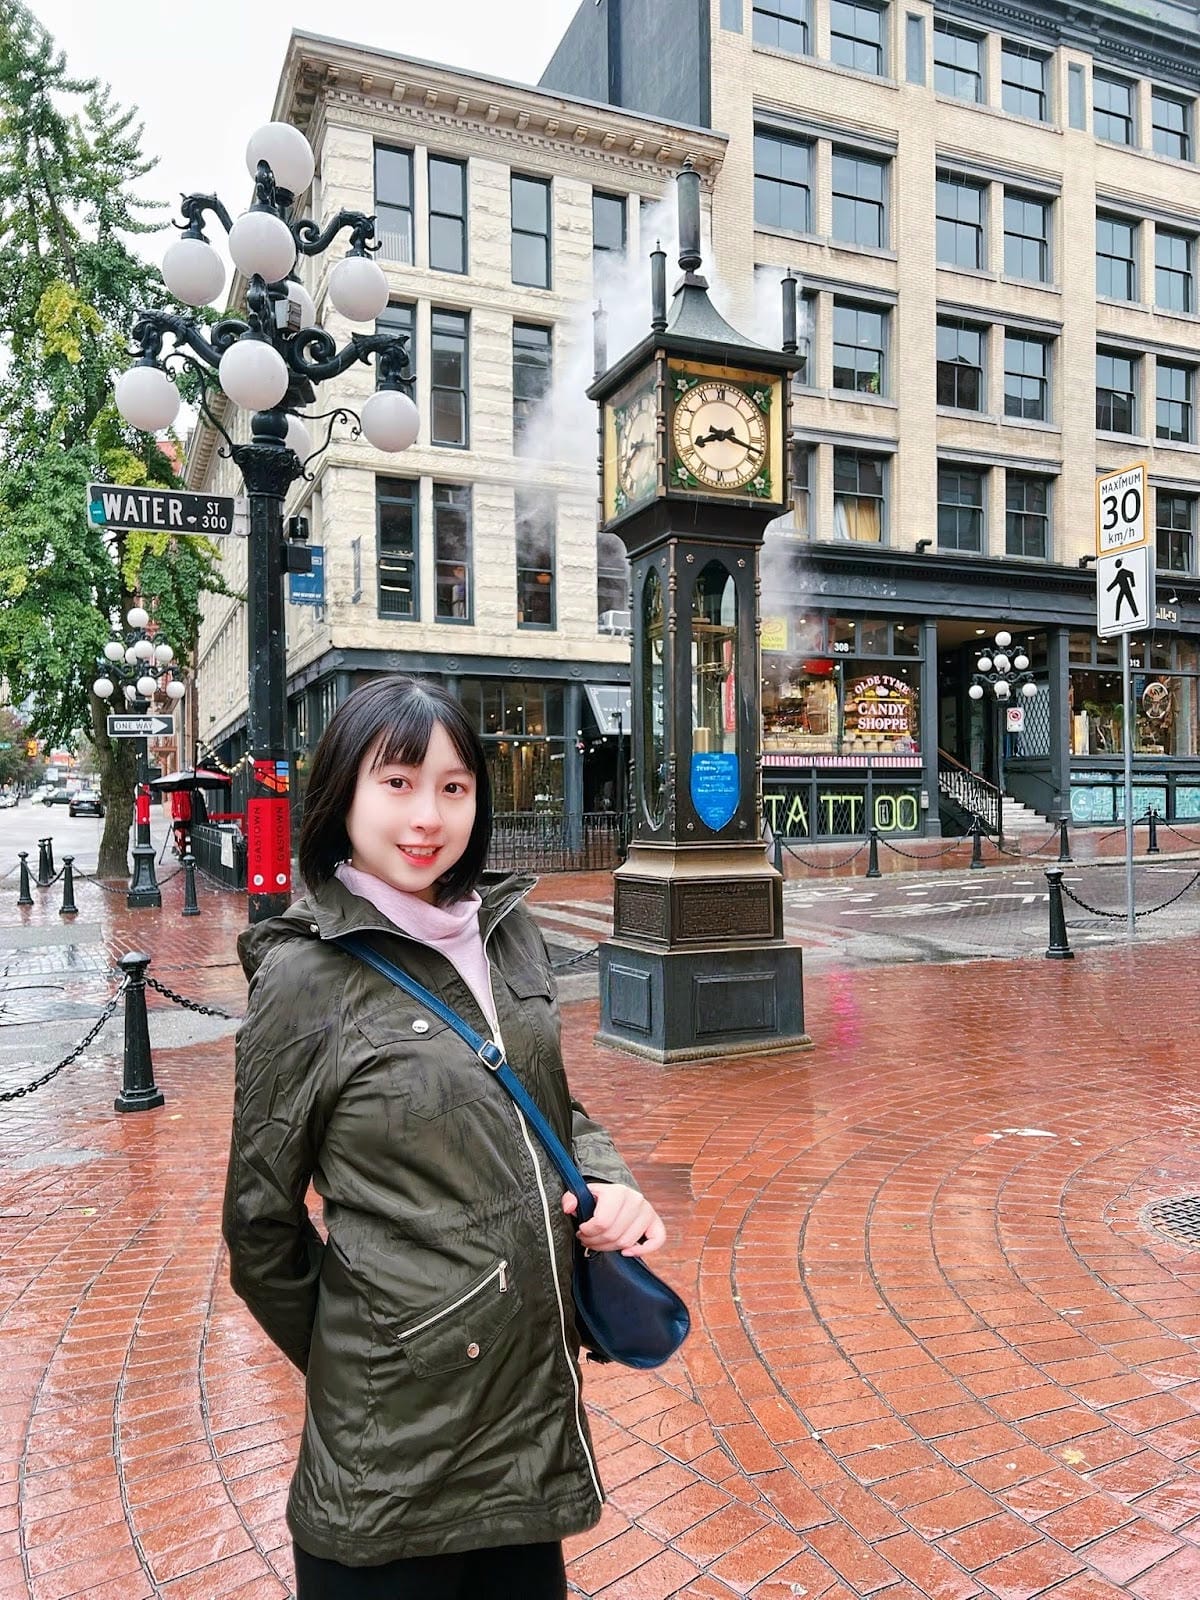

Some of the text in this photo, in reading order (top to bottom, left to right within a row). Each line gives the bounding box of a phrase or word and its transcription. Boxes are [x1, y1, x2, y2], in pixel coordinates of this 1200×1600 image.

[1101, 473, 1141, 495] MAXIMUM
[102, 493, 220, 526] WATER ST
[1102, 488, 1141, 530] 30
[202, 516, 227, 530] 300
[1108, 528, 1135, 544] km/h
[854, 675, 910, 694] OLDE TYME
[857, 702, 907, 716] CANDY
[115, 721, 153, 730] ONE WAY
[857, 717, 908, 730] SHOPPE
[254, 806, 262, 864] GASTOWN
[276, 805, 285, 863] GASTOWN
